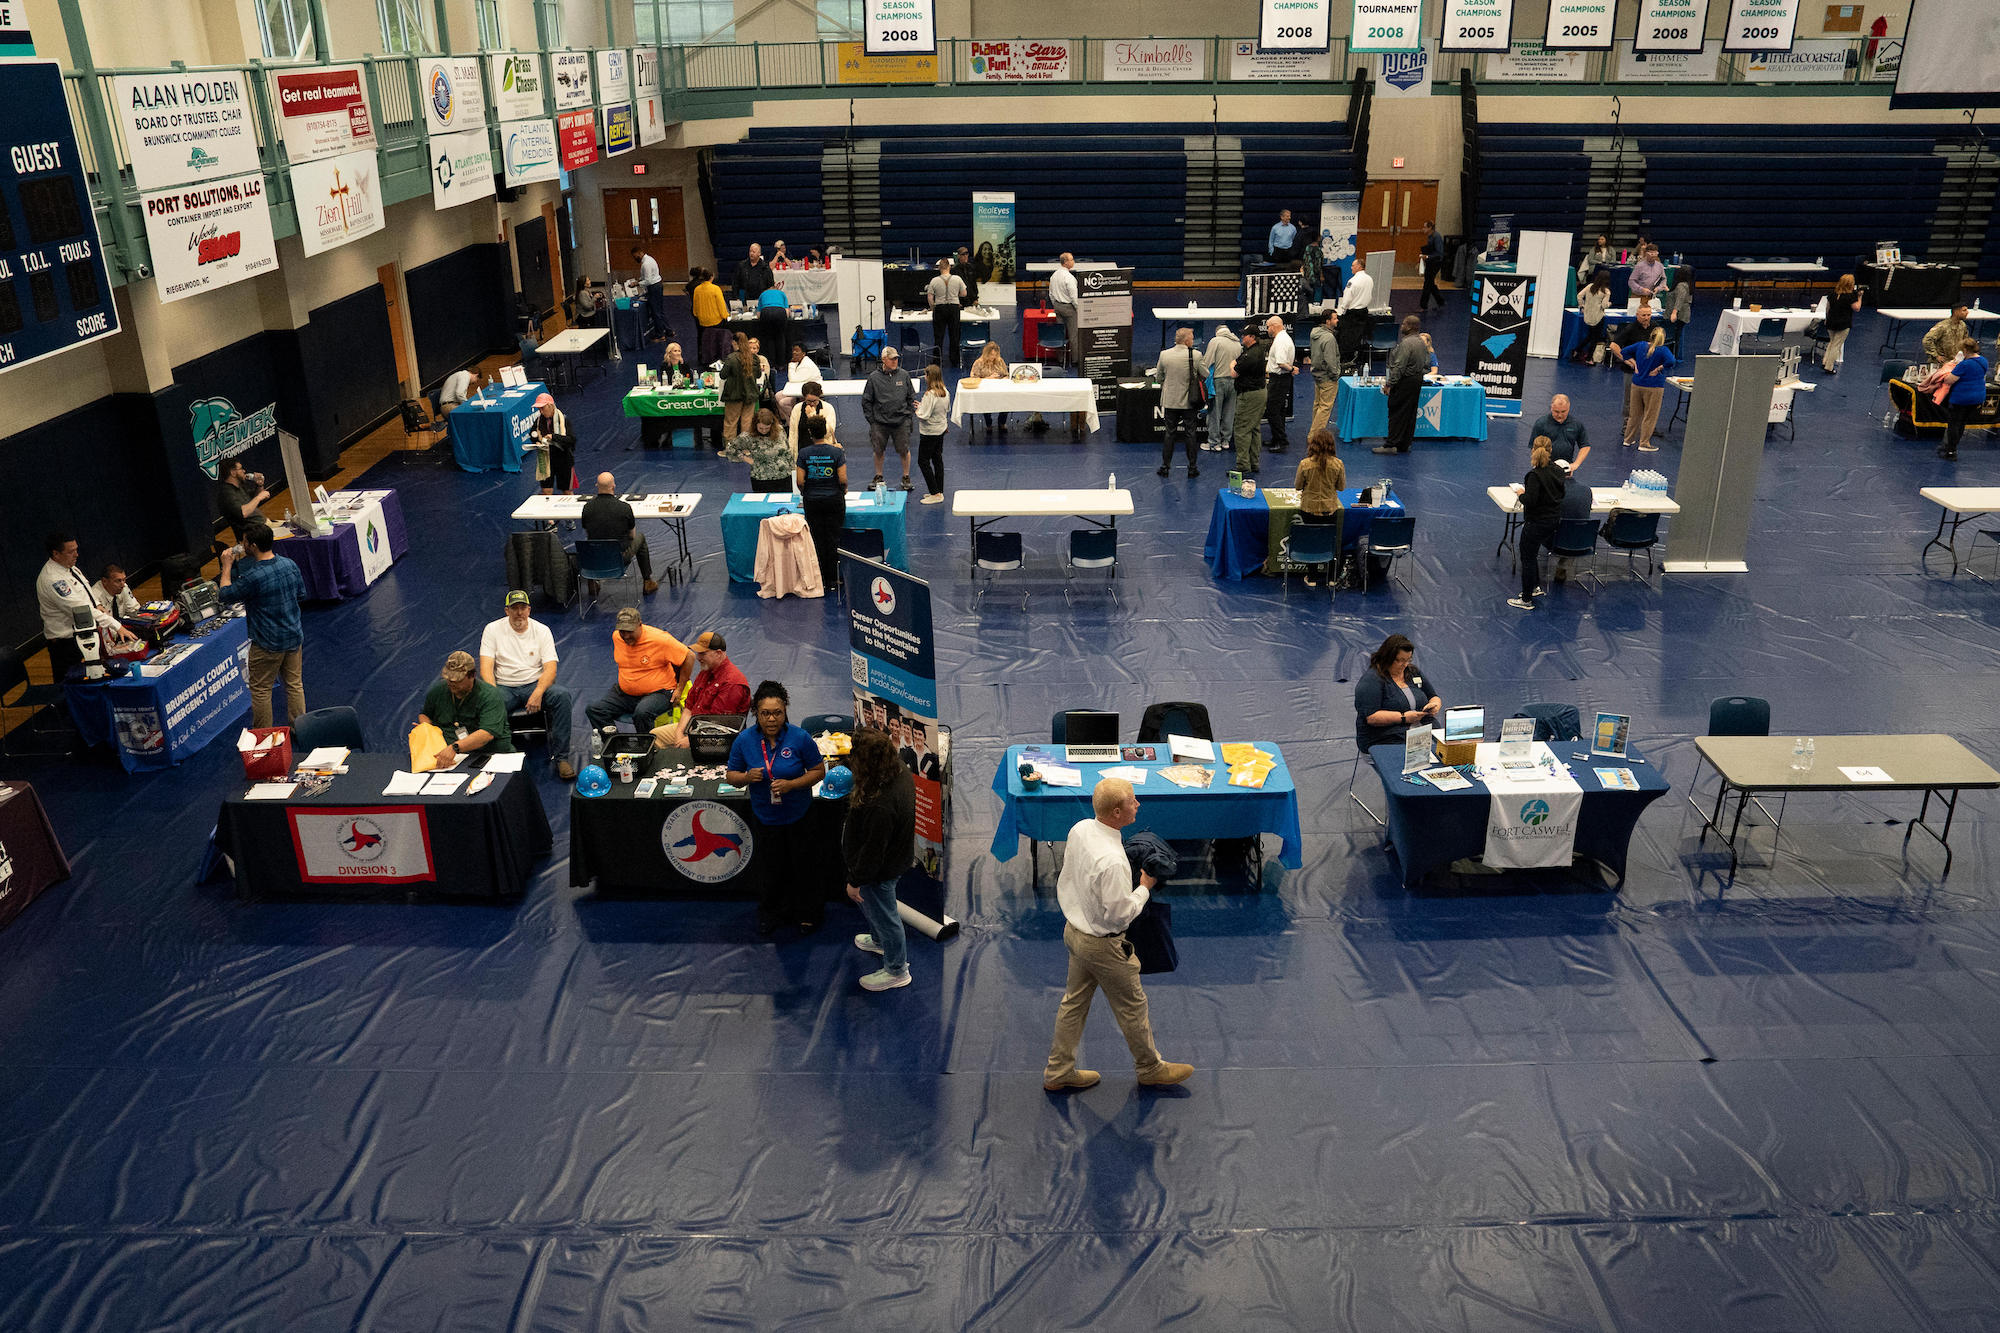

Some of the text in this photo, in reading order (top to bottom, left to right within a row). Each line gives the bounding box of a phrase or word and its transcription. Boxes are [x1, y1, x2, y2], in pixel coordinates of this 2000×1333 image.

[1274, 2, 1319, 10] CHAMPIONS
[1358, 5, 1418, 14] TOURNAMENT
[1456, 9, 1502, 17] CHAMPIONS
[1650, 10, 1696, 18] CHAMPIONS
[875, 12, 923, 20] CHAMPIONS
[882, 30, 918, 42] 2008
[1276, 26, 1313, 38] 2008
[1368, 26, 1404, 38] 2008
[1458, 27, 1495, 38] 2005
[1562, 25, 1598, 36] 2005
[1652, 28, 1688, 40] 2008
[1742, 27, 1779, 39] 2009
[1115, 43, 1193, 64] Kimball's
[1650, 54, 1689, 62] HOMES
[1768, 48, 1846, 64] Intracoastal
[514, 56, 532, 73] Grass
[988, 56, 1011, 72] Fun!
[1381, 52, 1428, 76] NJCAA
[1794, 64, 1843, 72] CORPORATION
[282, 82, 360, 104] Get real teamwork.
[516, 76, 538, 94] Chasers
[132, 81, 240, 110] ALAN HOLDEN
[136, 108, 242, 130] BOARD OF TRUSTEES, CHAIR
[520, 122, 550, 134] ATLANTIC
[144, 126, 242, 147] BRUNSWICK COMMUNITY COLLEGE
[521, 136, 552, 147] INTERNAL
[11, 142, 60, 175] GUEST
[454, 152, 490, 170] ATLANTIC DENTAL
[522, 148, 553, 160] MEDICINE
[634, 164, 646, 174] EXIT
[148, 180, 261, 217] PORT SOLUTIONS, LLC
[167, 202, 253, 227] CONTAINER IMPORT AND EXPORT
[316, 193, 363, 227] Zion Hill
[978, 206, 1010, 216] RealEyes
[188, 222, 218, 251] Woody
[20, 240, 92, 273] T.O.L. FOULS
[166, 276, 210, 296] RIEGELWOOD, NC
[1084, 277, 1098, 286] NC
[1486, 294, 1494, 304] S
[1512, 295, 1523, 304] W
[76, 312, 108, 337] SCORE
[1478, 360, 1512, 374] Proudly
[1470, 372, 1518, 385] Serving the
[657, 399, 693, 410] Great
[220, 426, 276, 460] COMMUNITY COLLEGE
[851, 608, 922, 645] Career Opportunities
[853, 620, 920, 656] From the Mountains
[864, 635, 908, 660] to the Coast.
[165, 655, 234, 714] BRUNSWICK COUNTY
[870, 668, 905, 688] APPLY TODAY
[166, 666, 240, 730] EMERGENCY SERVICES
[870, 676, 931, 708] ncdot.gov/careers
[666, 812, 681, 831] STATE
[680, 806, 690, 814] OF
[718, 806, 748, 833] CAROLINA
[1492, 826, 1521, 837] FORT
[664, 842, 696, 878] DEPARTMENT
[708, 845, 751, 881] TRANSPORTATION
[338, 865, 397, 875] DIVISION 3
